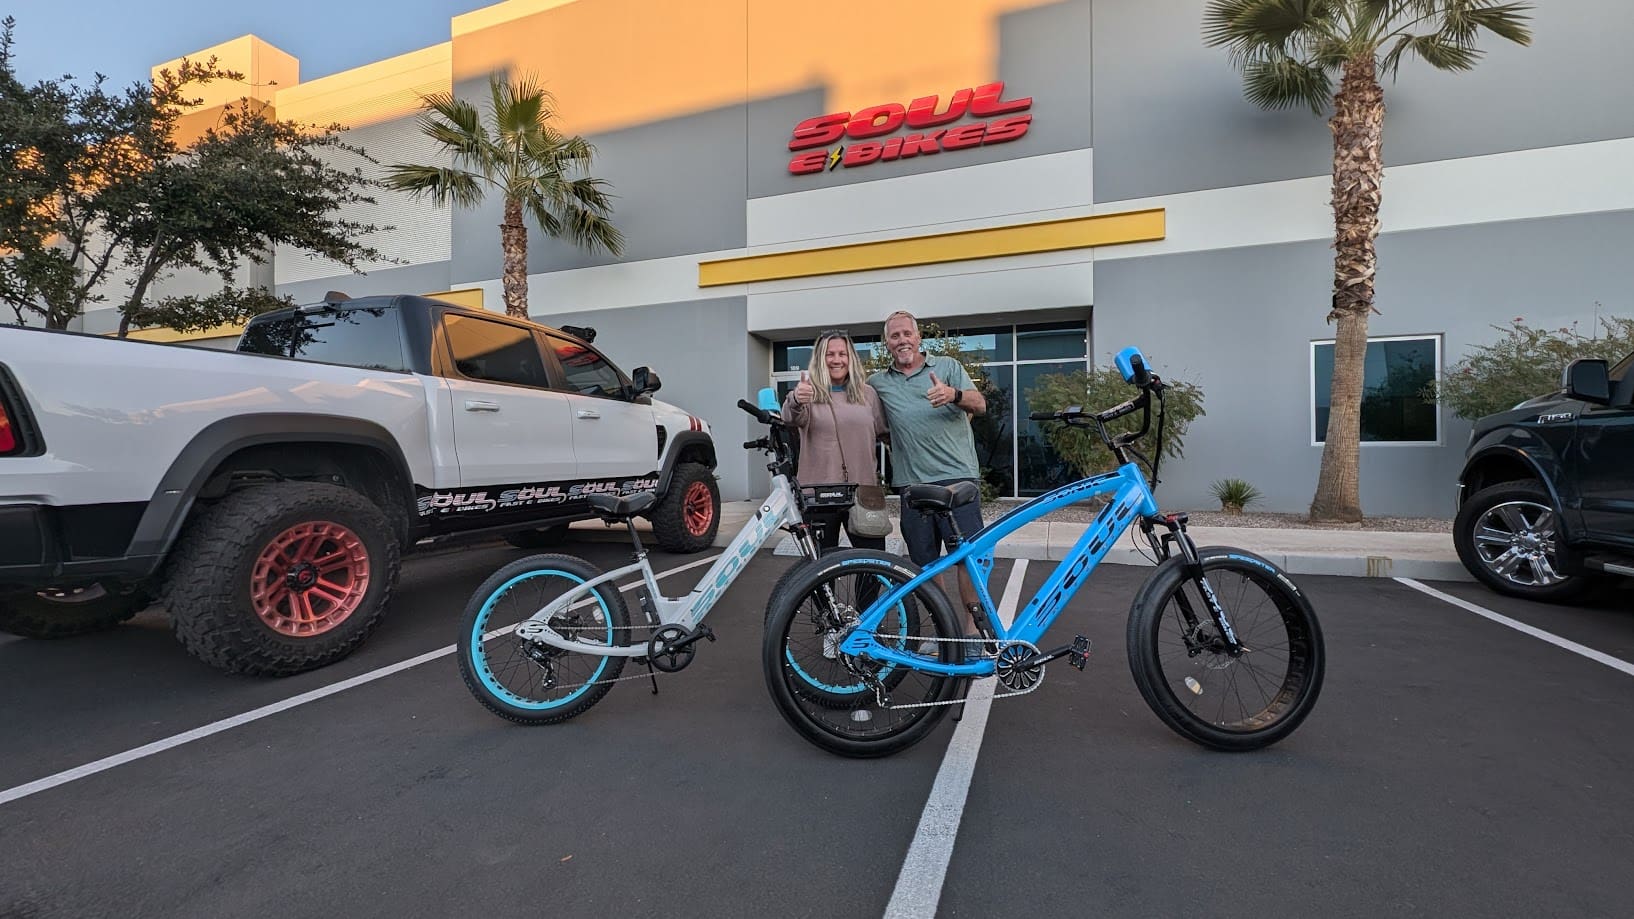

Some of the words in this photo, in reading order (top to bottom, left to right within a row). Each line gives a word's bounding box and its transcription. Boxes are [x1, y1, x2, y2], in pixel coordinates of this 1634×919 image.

[788, 81, 1033, 151] SOUL
[788, 150, 829, 175] E
[843, 114, 1033, 168] BIKES
[498, 486, 563, 503] SOUL
[1036, 492, 1142, 627] SOUL
